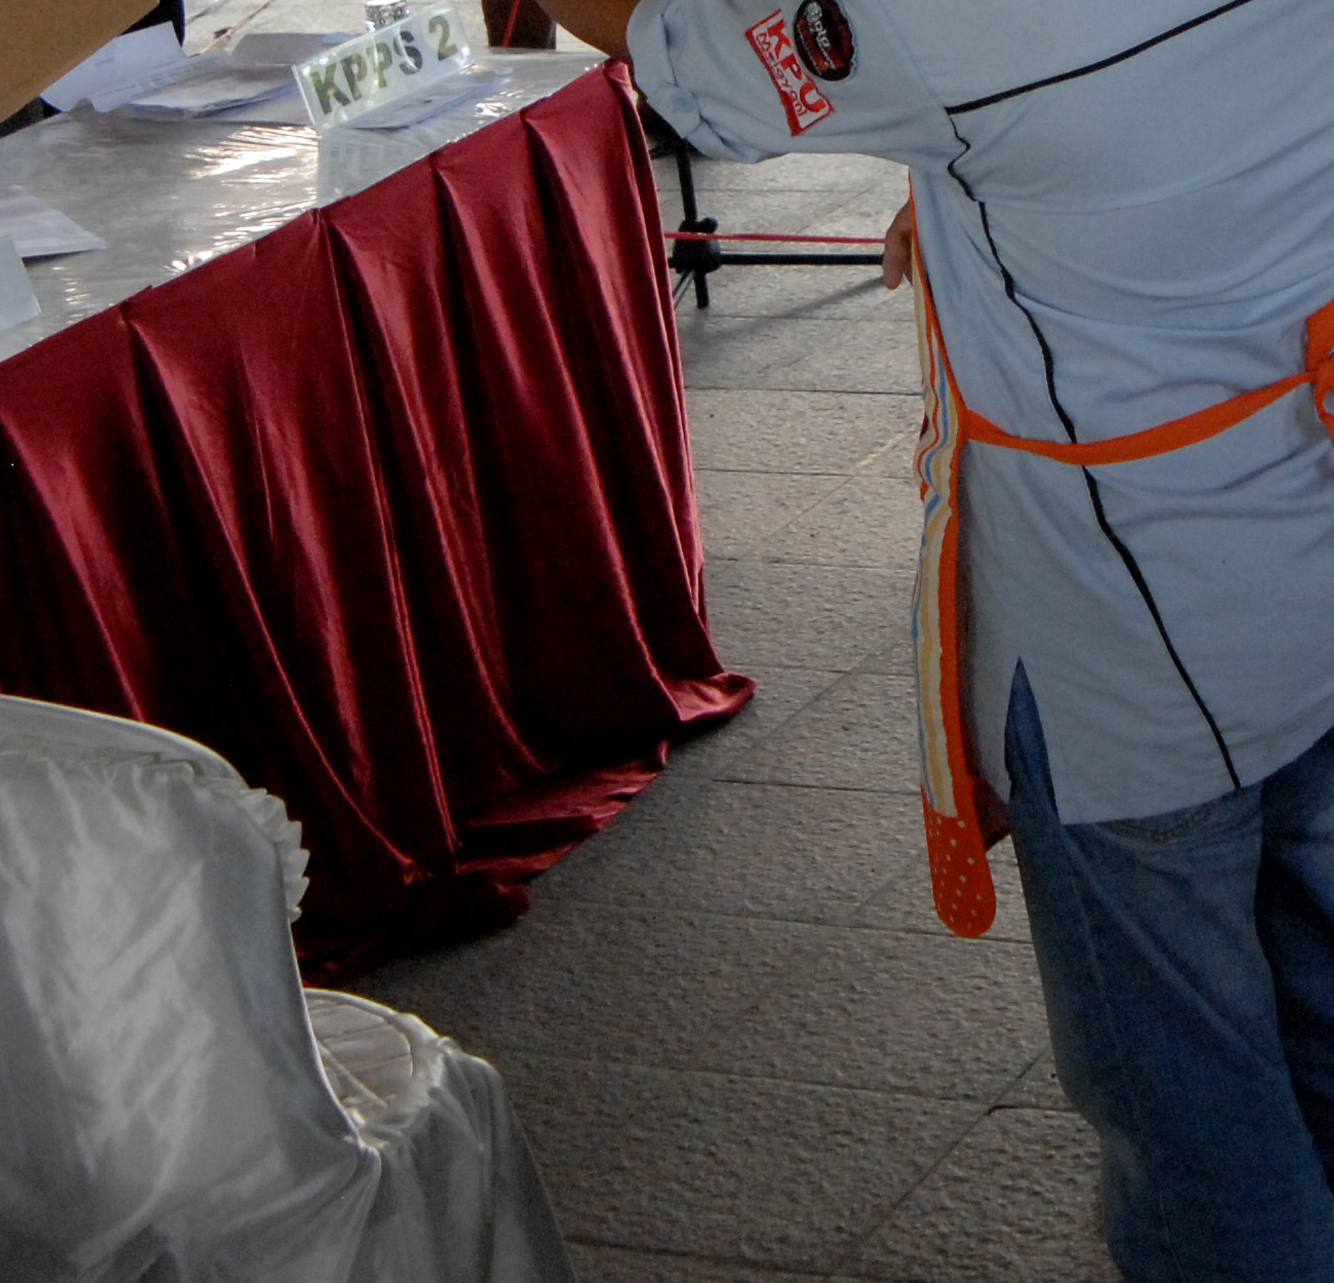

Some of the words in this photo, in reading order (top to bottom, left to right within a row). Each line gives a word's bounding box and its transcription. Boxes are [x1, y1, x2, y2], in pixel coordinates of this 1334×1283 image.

[310, 30, 423, 114] KPPS
[428, 15, 459, 62] 2
[767, 20, 827, 113] KPU
